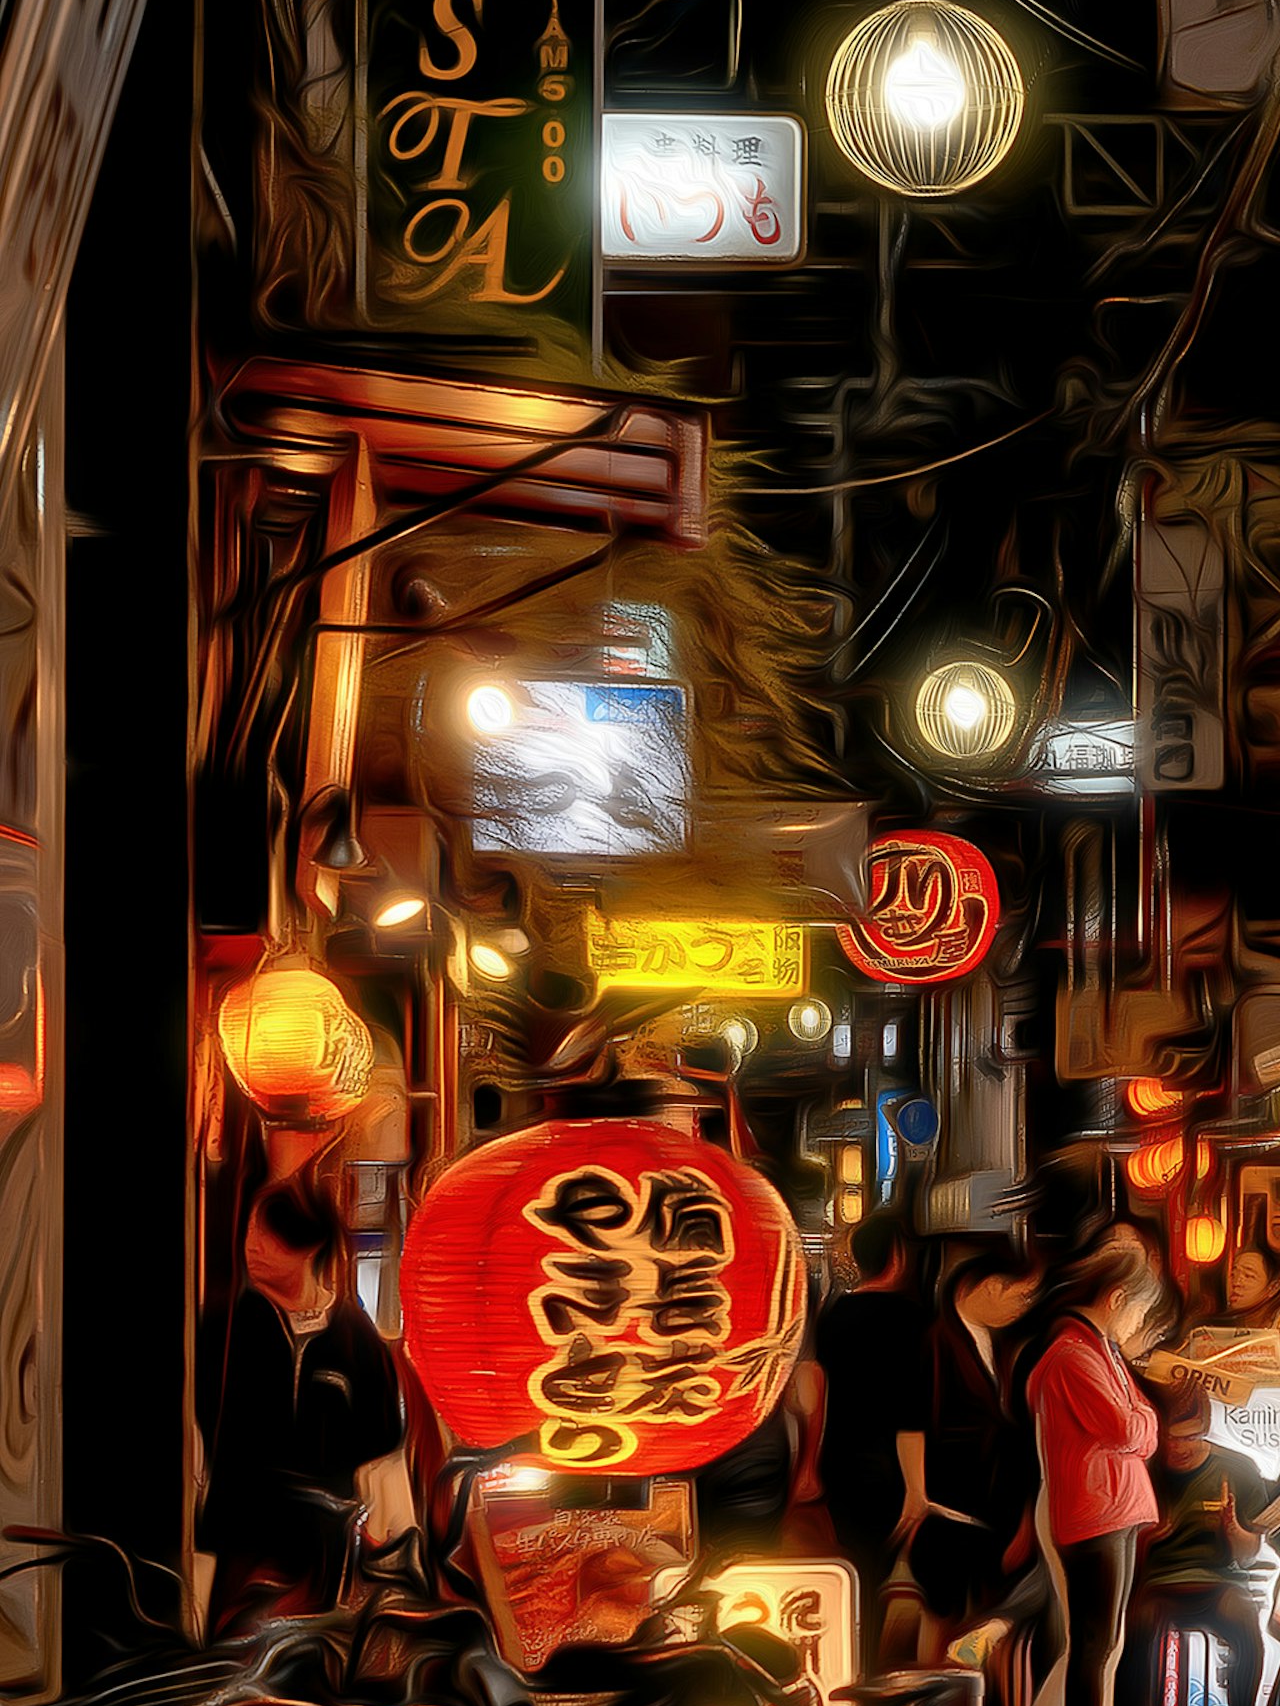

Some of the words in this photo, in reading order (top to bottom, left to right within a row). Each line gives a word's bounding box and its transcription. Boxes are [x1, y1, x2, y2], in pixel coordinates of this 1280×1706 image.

[620, 178, 781, 245] いつも
[1170, 1363, 1230, 1397] OPEN
